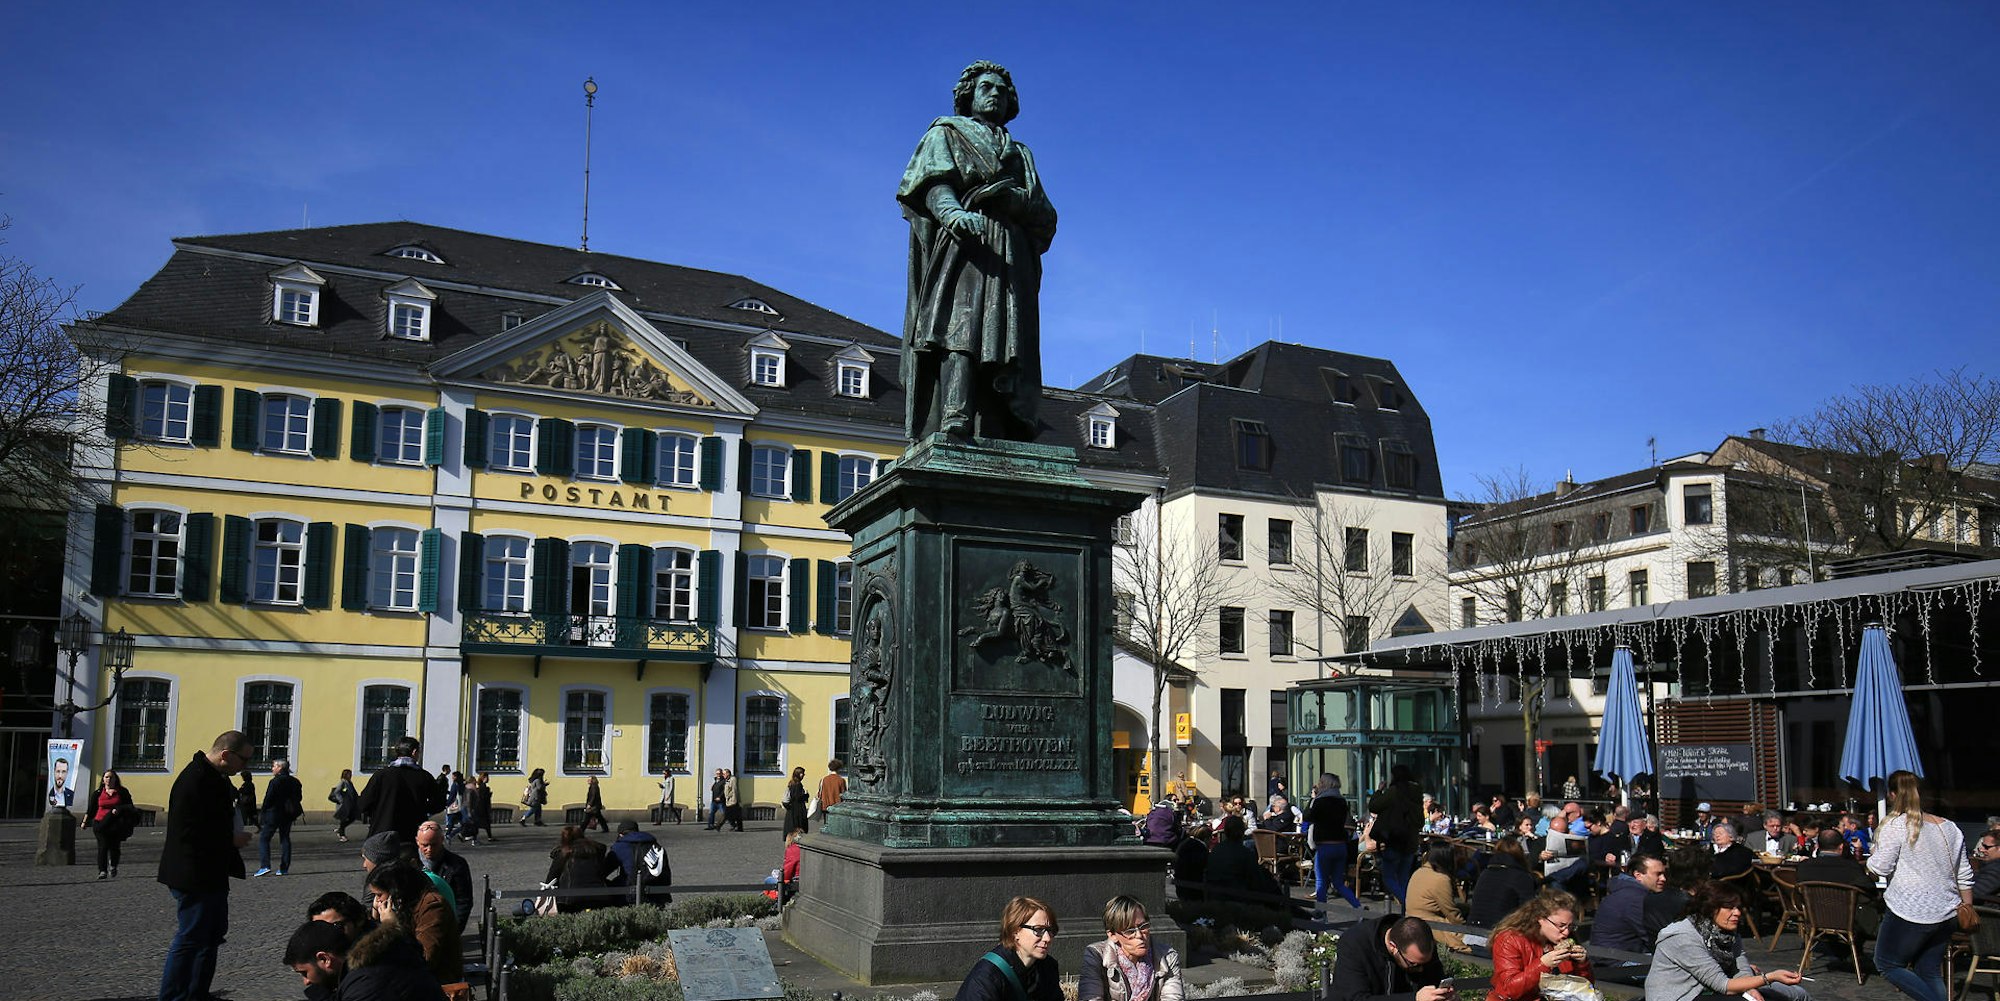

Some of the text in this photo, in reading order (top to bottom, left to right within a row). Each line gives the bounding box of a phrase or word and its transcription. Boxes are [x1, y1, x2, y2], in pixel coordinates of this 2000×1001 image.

[520, 482, 672, 512] POSTAMT
[981, 704, 1054, 720] LUDWIG
[1331, 734, 1357, 744] Tiefgarage
